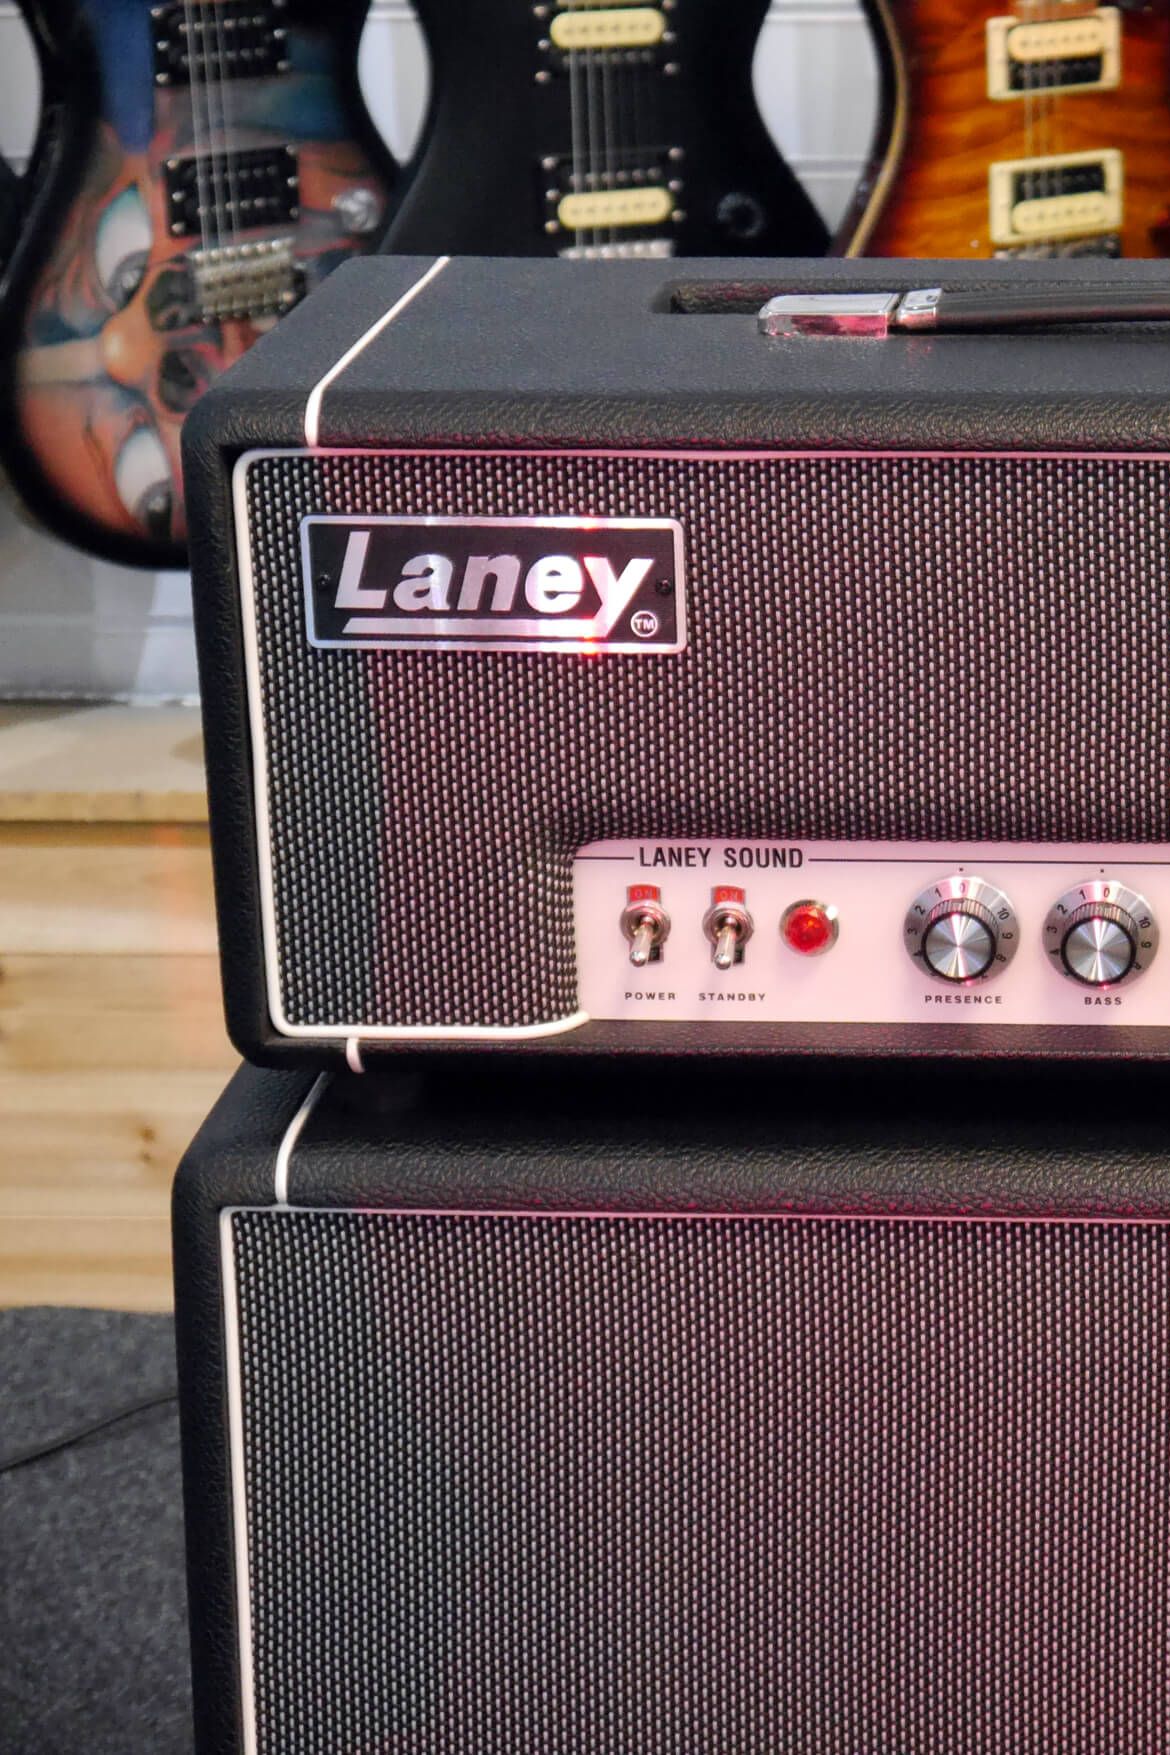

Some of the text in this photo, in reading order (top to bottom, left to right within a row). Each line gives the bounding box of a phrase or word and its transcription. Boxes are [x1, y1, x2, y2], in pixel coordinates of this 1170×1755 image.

[335, 531, 654, 638] Laney
[639, 847, 804, 869] LANEY SOUND
[907, 927, 918, 936] 3
[914, 905, 926, 915] 2
[934, 887, 942, 898] 1
[997, 907, 1010, 920] 10
[1046, 925, 1058, 934] 3
[1057, 903, 1068, 915] 2
[1079, 889, 1086, 900] 1
[1103, 887, 1110, 898] 0
[1138, 916, 1151, 929] 10
[624, 992, 677, 1001] POWER
[698, 992, 767, 1002] STANDBY
[924, 995, 1003, 1005] PRESENCE
[1084, 996, 1123, 1006] BASS
